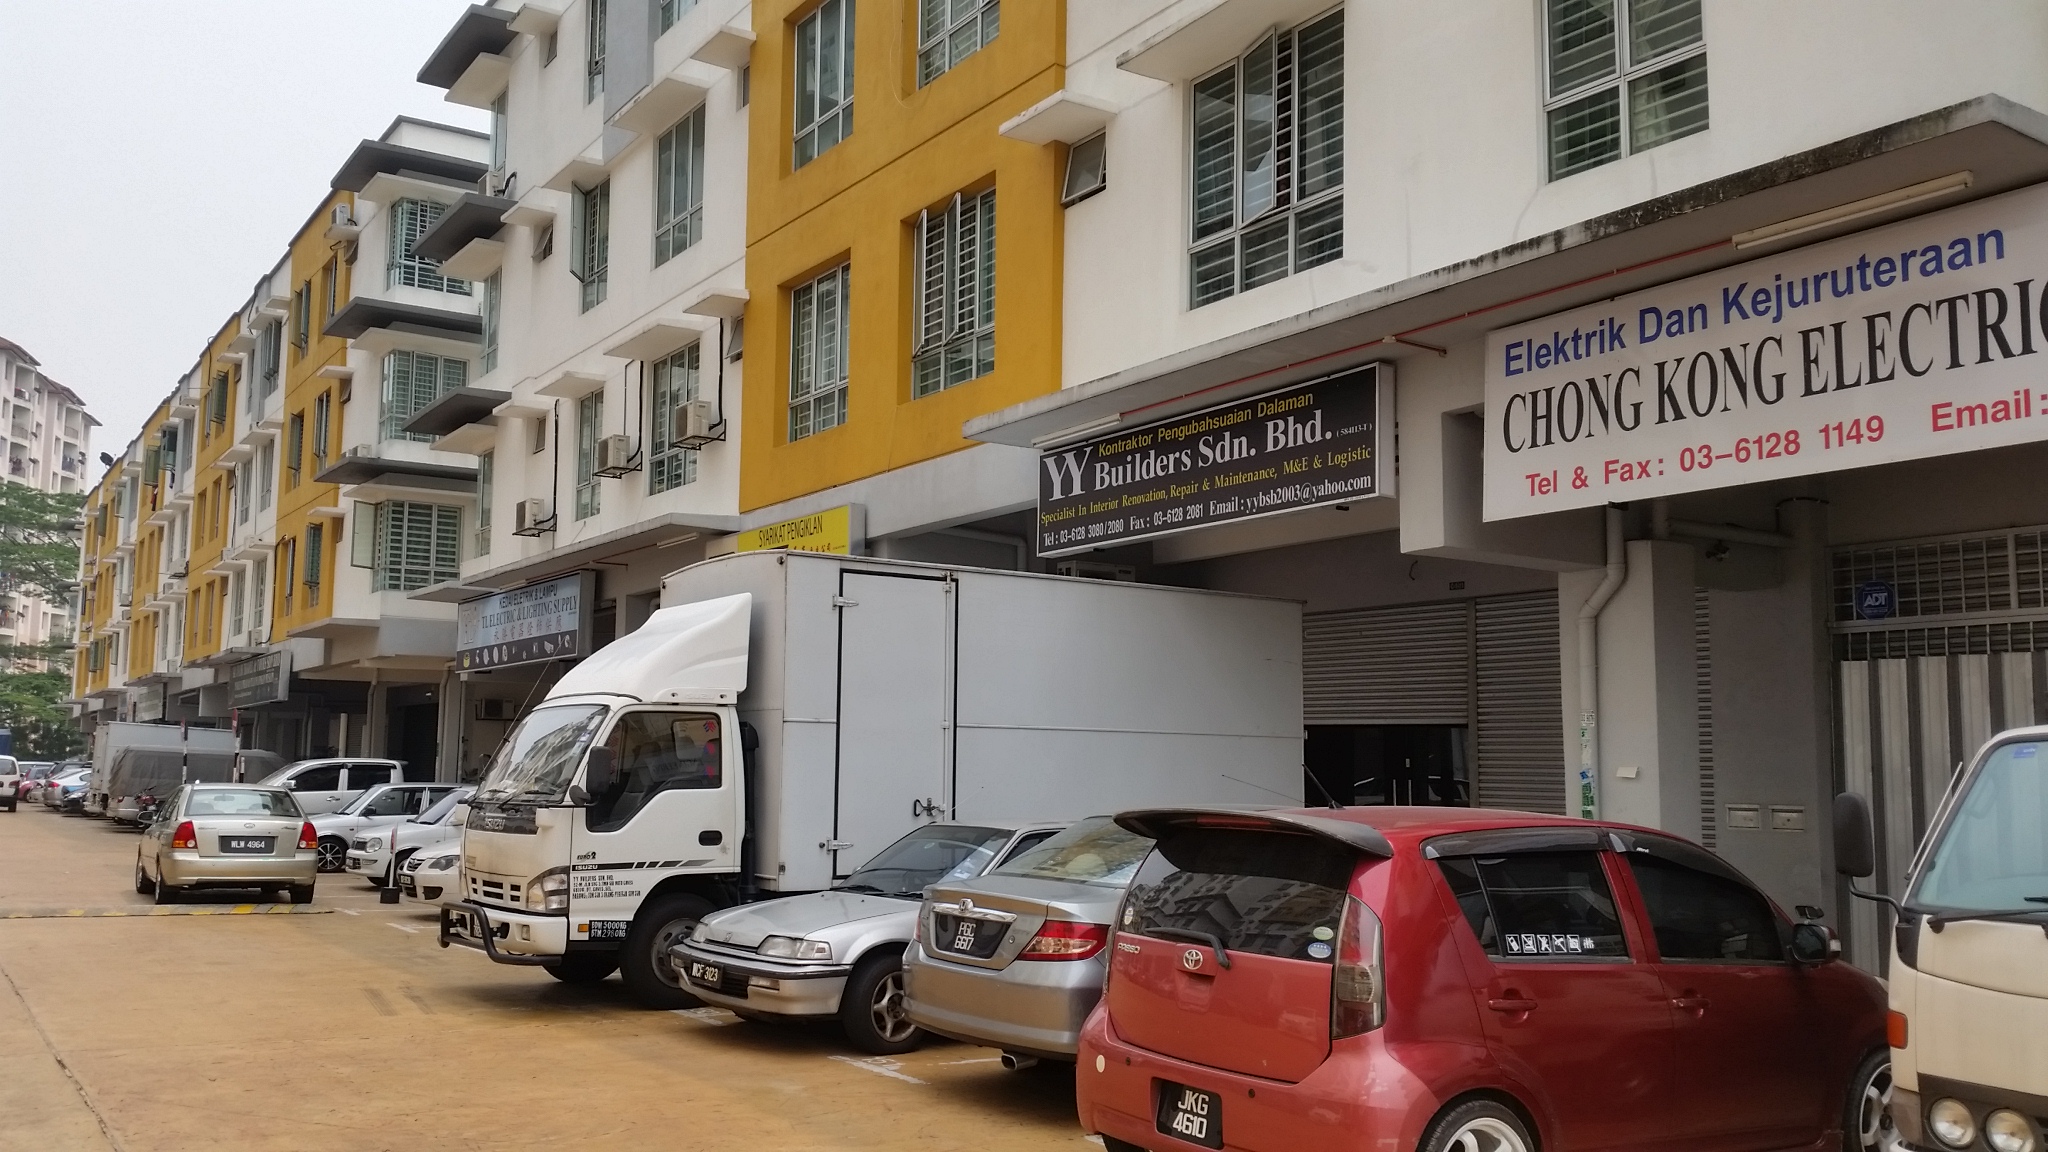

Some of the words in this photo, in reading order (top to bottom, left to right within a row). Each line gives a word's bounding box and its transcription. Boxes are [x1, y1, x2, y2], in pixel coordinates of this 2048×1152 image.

[1504, 316, 1625, 377] Elektrik
[1639, 302, 1709, 345] Dan
[1723, 228, 2006, 325] Kejuruteraan
[1503, 366, 1643, 454] CHONG
[1653, 336, 1787, 426] KONG
[1798, 278, 2048, 399] ELECTRI
[1098, 432, 1153, 458] Kontraktor
[1157, 410, 1252, 443] Pengubahsuaian
[1257, 393, 1314, 418] Dalaman
[1043, 446, 1093, 501] YY
[1093, 449, 1192, 492] Builders
[1198, 431, 1257, 468] Sdn.
[1264, 409, 1333, 453] Bhd.
[1525, 464, 1559, 497] Tel
[1571, 461, 1590, 490] &
[1678, 429, 1801, 473] 03-6128
[1819, 415, 1885, 450] 1149
[1040, 507, 1076, 528] Specialist
[1078, 504, 1087, 516] In
[1090, 498, 1119, 514] Interior
[1122, 488, 1168, 507] Renovation,
[1170, 480, 1199, 499] Repair
[1202, 478, 1211, 491] &
[1214, 467, 1278, 489] Maintenance,
[1283, 456, 1309, 475] M&E
[1313, 454, 1323, 469] &
[1328, 445, 1372, 468] Logistic
[758, 523, 786, 548] SYARIKAT
[787, 514, 823, 541] PENGIKLAN
[1060, 525, 1086, 544] 03-6128
[1088, 518, 1124, 538] 3080/2080
[1153, 507, 1184, 526] 03-6128
[1186, 503, 1204, 520] 2081
[540, 583, 558, 601] LAMPU
[1863, 592, 1888, 607] ADT
[489, 609, 517, 628] ELECTRIC
[516, 609, 522, 622] &
[522, 601, 553, 621] LIGHTING
[553, 595, 578, 614] SUPPLY
[246, 840, 265, 849] 4964
[954, 936, 974, 951] 6617
[958, 921, 977, 937] PGC
[1118, 942, 1140, 954] PASSO
[704, 966, 719, 982] 3123
[1177, 1089, 1210, 1116] JKG
[1172, 1113, 1208, 1140] 4610
